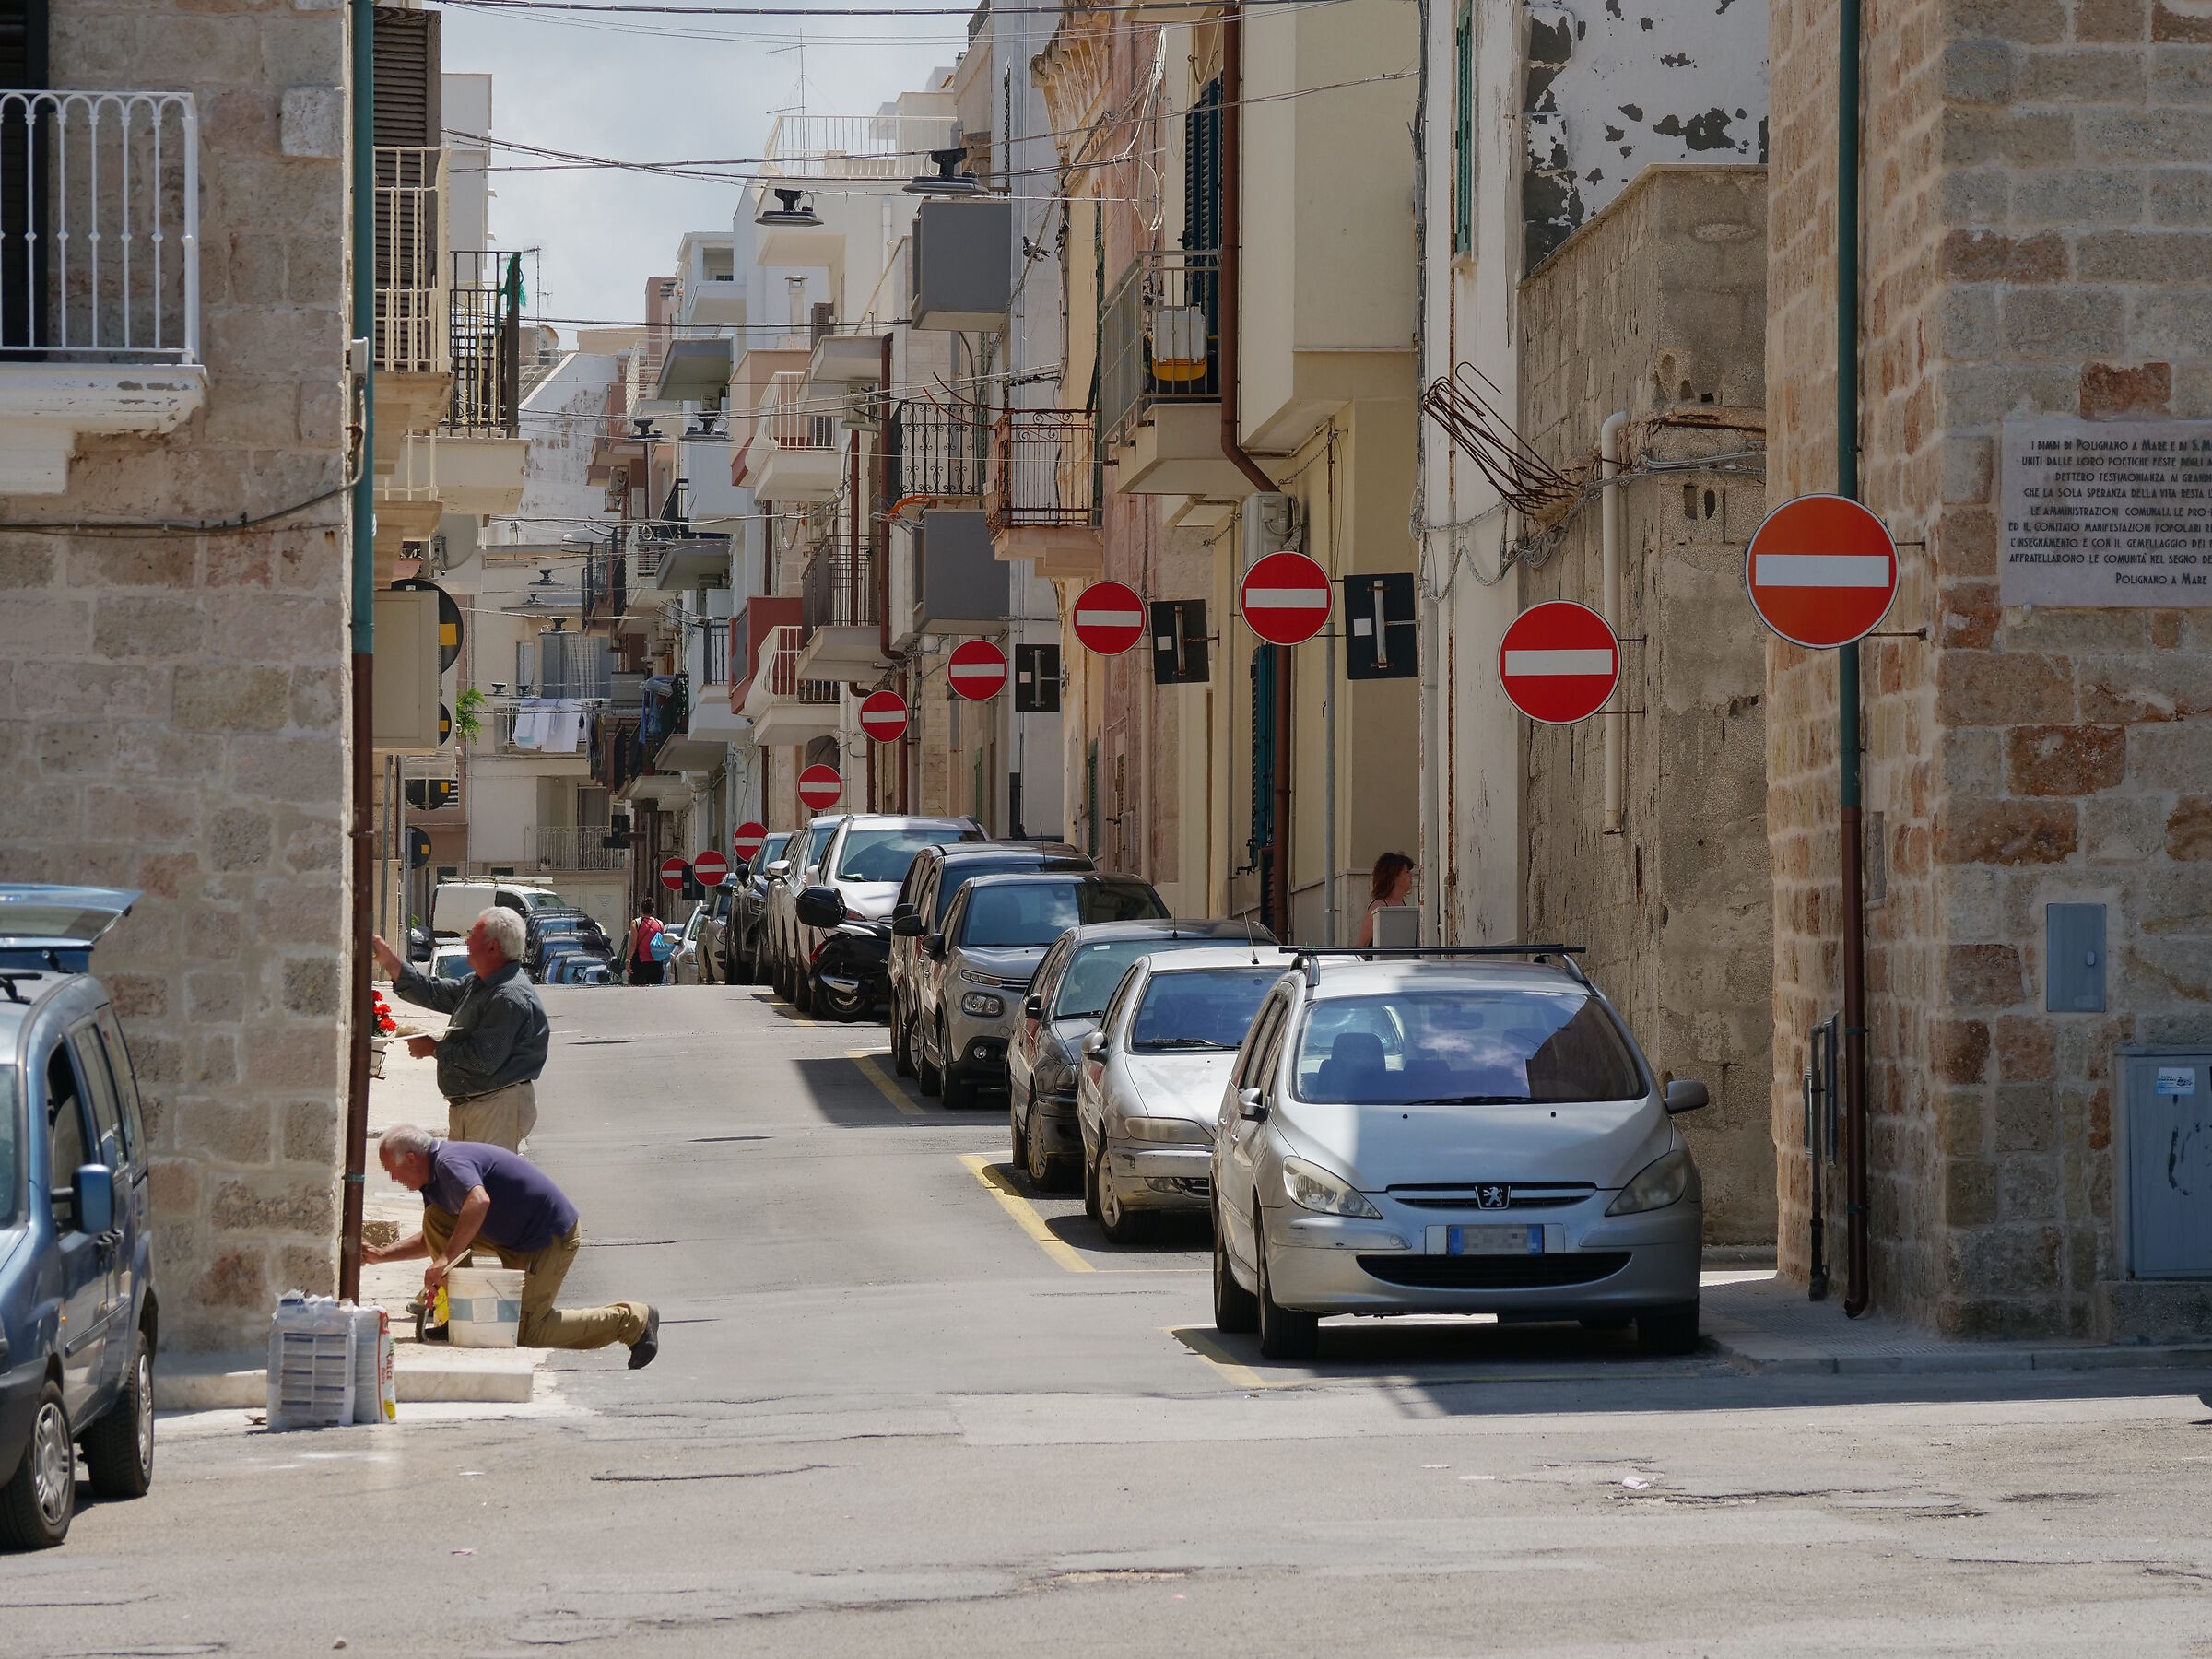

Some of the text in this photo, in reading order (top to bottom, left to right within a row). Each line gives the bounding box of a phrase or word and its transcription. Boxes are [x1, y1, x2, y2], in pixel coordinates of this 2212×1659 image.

[2038, 441, 2060, 451] BIMBI
[2065, 441, 2072, 451] DI
[2077, 439, 2128, 451] POLIGNANO
[2142, 439, 2167, 451] MARE
[2179, 441, 2188, 451] DI
[2022, 456, 2042, 466] UNITI
[2047, 456, 2072, 466] DALLE
[2077, 456, 2104, 466] LORO
[2109, 456, 2148, 466] POETICHE
[2153, 456, 2175, 466] FESTE
[2055, 472, 2094, 482] DETTERO
[2100, 472, 2164, 482] TESTIMONIANZA
[2171, 472, 2177, 482] AI
[2024, 488, 2039, 498] CHE
[2043, 488, 2053, 498] LA
[2058, 488, 2082, 498] SOLA
[2088, 488, 2126, 498] SPERANZA
[2131, 488, 2157, 498] DELLA
[2160, 488, 2176, 498] VITA
[2182, 488, 2204, 498] RESTA
[2031, 507, 2041, 516] LE
[2043, 507, 2118, 516] AMMINISTRAZIONI
[2175, 507, 2183, 516] LE
[2008, 523, 2018, 532] ED
[2024, 523, 2031, 532] IL
[2035, 523, 2079, 532] COMITATO
[2155, 523, 2201, 532] POPOLARI
[2092, 538, 2111, 548] CON
[2115, 538, 2122, 548] IL
[2127, 538, 2187, 548] GEMELLAGGIO
[2192, 538, 2205, 548] DEI
[2009, 554, 2085, 564] AFFRATELLARONO
[2089, 554, 2100, 564] LE
[2150, 554, 2164, 564] NEL
[2169, 554, 2197, 564] SEGNO
[2116, 573, 2167, 584] POLIGNANO
[2182, 573, 2207, 584] MARE
